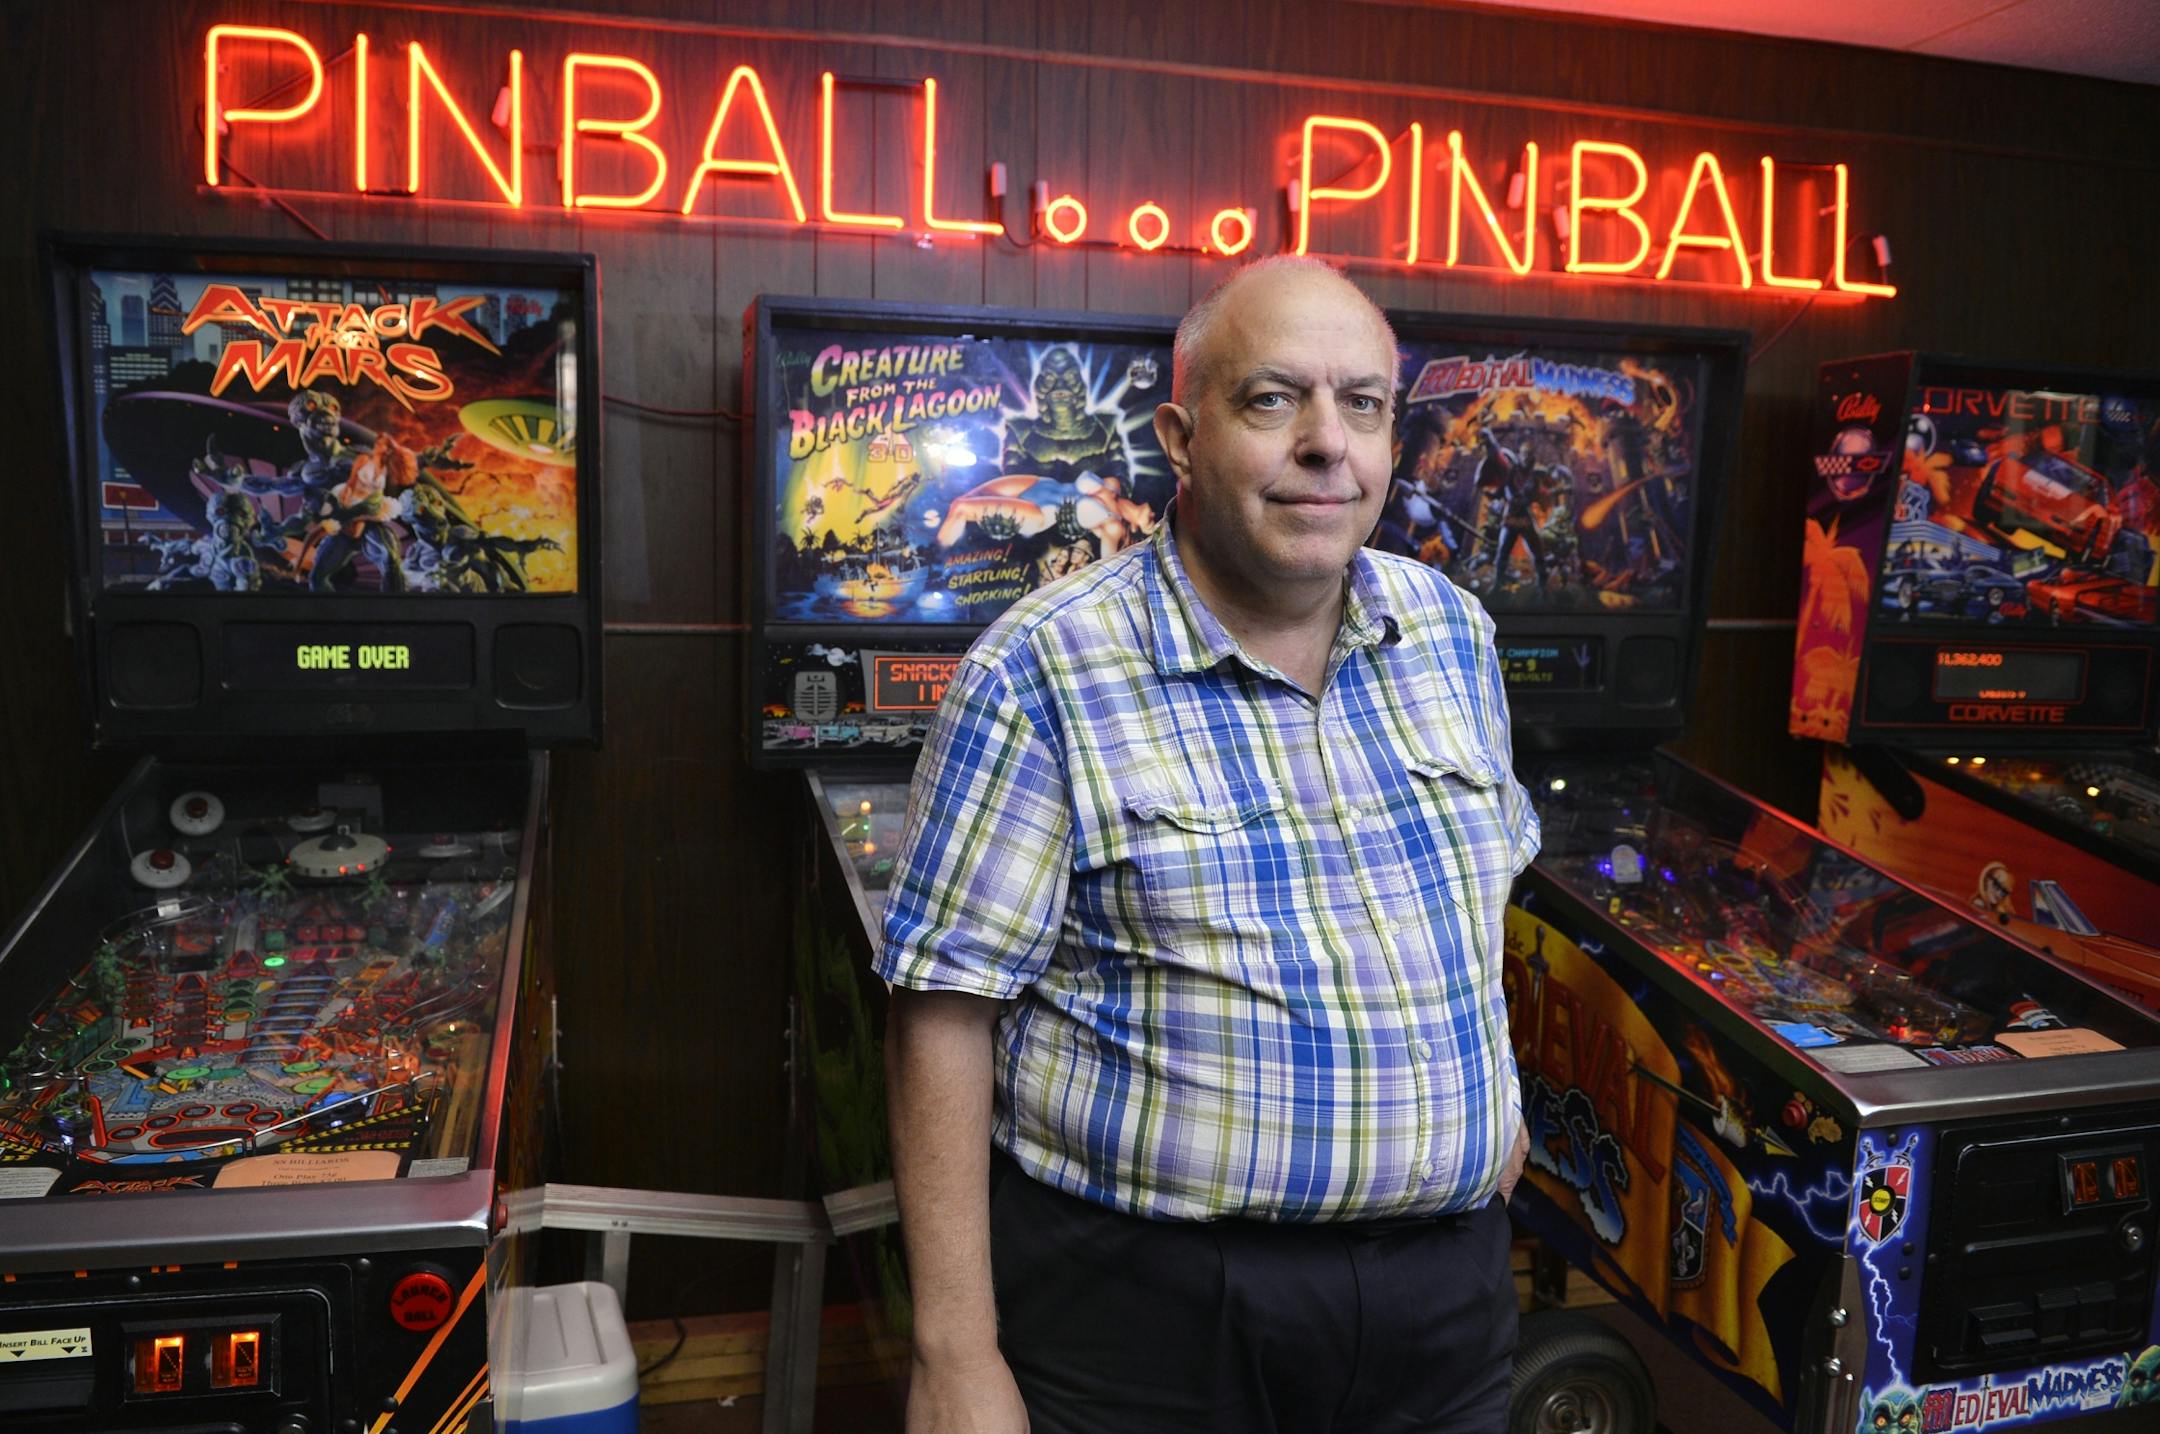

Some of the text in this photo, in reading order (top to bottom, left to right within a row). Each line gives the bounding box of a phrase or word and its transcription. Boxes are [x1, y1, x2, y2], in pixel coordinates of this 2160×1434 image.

[204, 23, 1004, 236] PINBALL
[1297, 115, 1898, 299] PINBALL
[181, 283, 501, 355] ATTACK
[209, 338, 454, 415] MARS
[811, 344, 965, 398] CREATURE
[846, 376, 938, 408] FROM THE
[789, 383, 1002, 460] BLACK LAGOON
[944, 543, 1013, 569] AMAZING!
[948, 563, 1029, 589] STARTLING!
[955, 583, 1031, 607] SHOCKING!
[297, 645, 410, 670] GAME OVER
[1949, 704, 2065, 722] CORVETTE
[50, 1337, 73, 1345] FACE
[74, 1335, 86, 1344] UP
[1922, 1362, 2123, 1433] MEDIEVAL MADNESS
